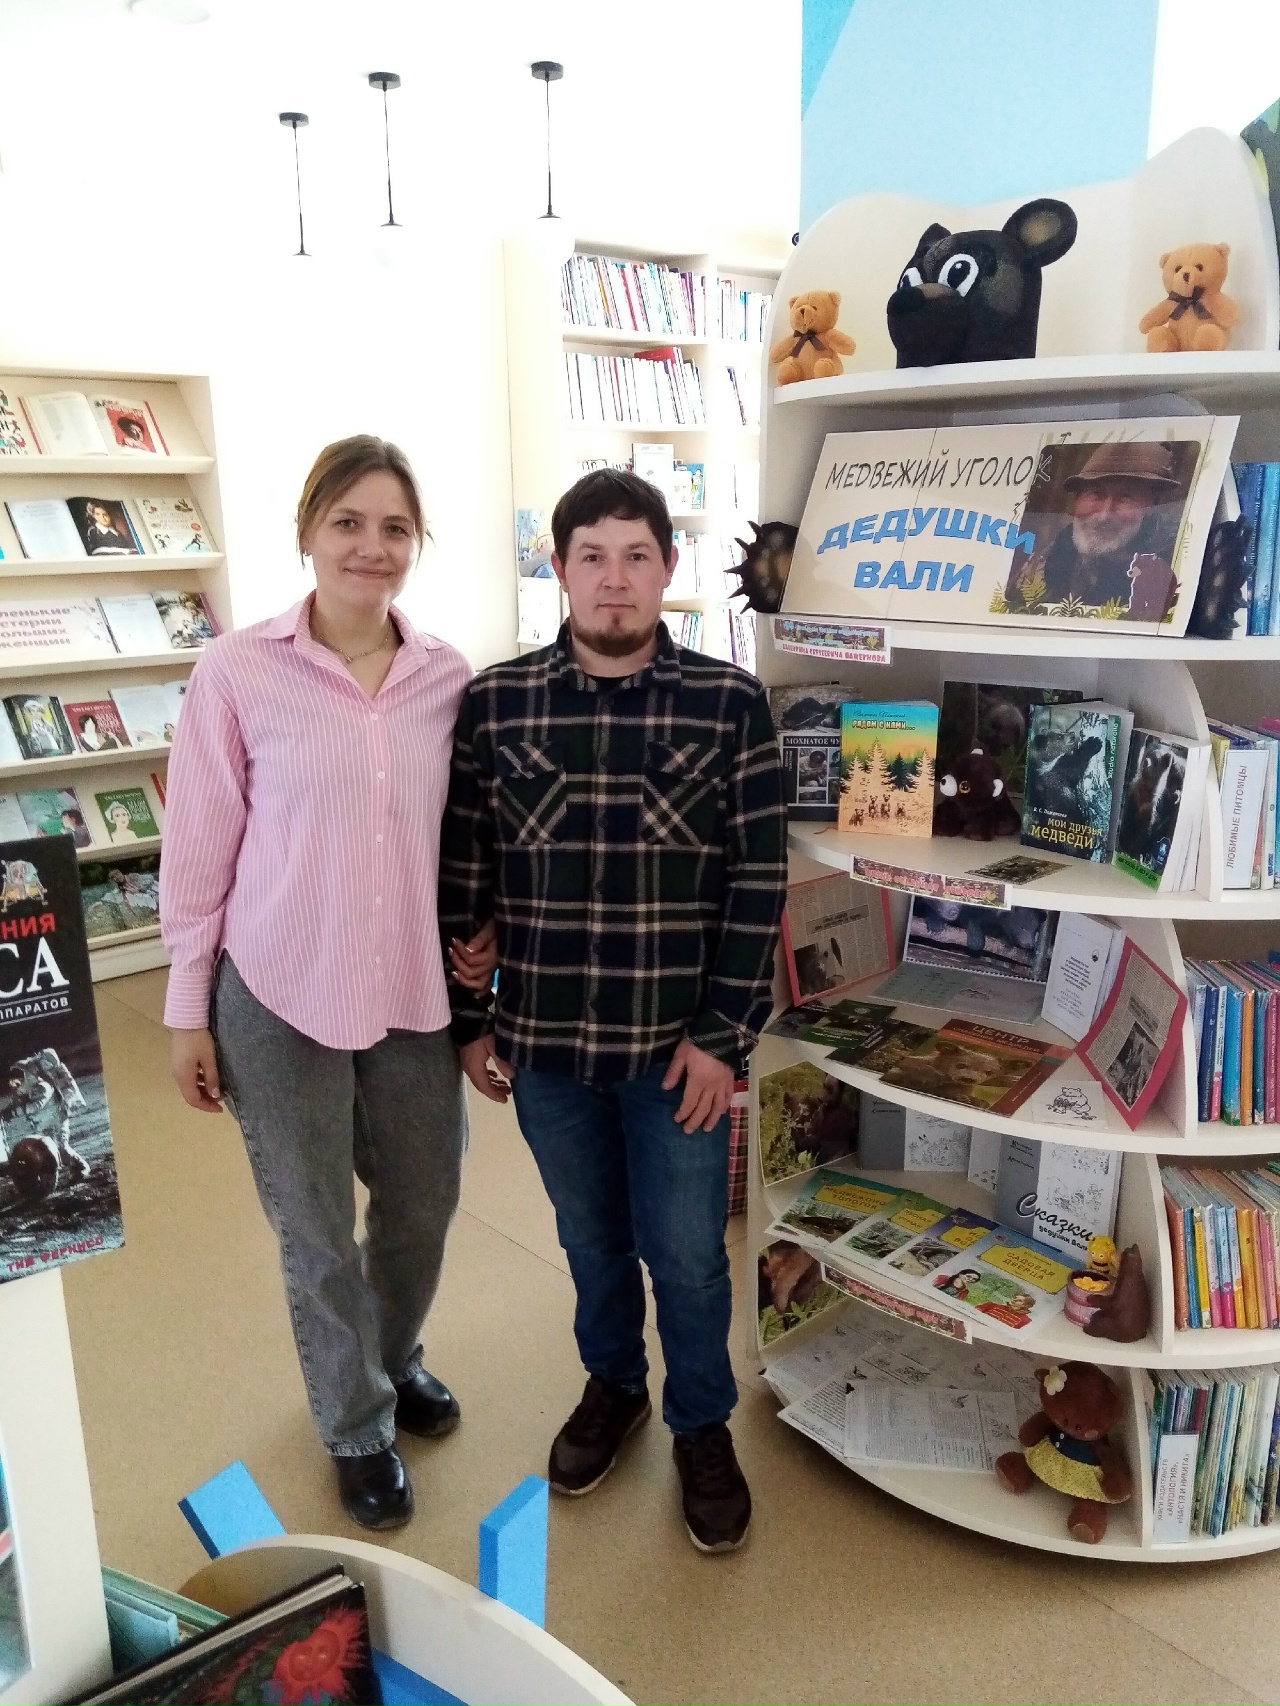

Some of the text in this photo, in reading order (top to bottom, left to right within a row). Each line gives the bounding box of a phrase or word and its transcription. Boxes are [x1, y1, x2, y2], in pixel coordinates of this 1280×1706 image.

[825, 448, 1052, 491] МЕДВЕЖИЙ УГОЛОК
[816, 507, 1036, 555] ДЕДУШКИ
[853, 560, 975, 594] ВАЛИ
[785, 737, 829, 745] МОХНАТОЕ
[1226, 765, 1248, 869] ЛЮБИМЫЕ ПИТОМЦЫ
[1030, 824, 1095, 849] медведи
[0, 912, 56, 941] НИЯ
[0, 935, 70, 999] СА
[972, 1025, 1030, 1044] ЦЕНТР
[1015, 1192, 1095, 1242] Сказки
[1003, 1257, 1045, 1281] ДВЕРЦА
[1006, 1251, 1057, 1277] САДОВАЯ
